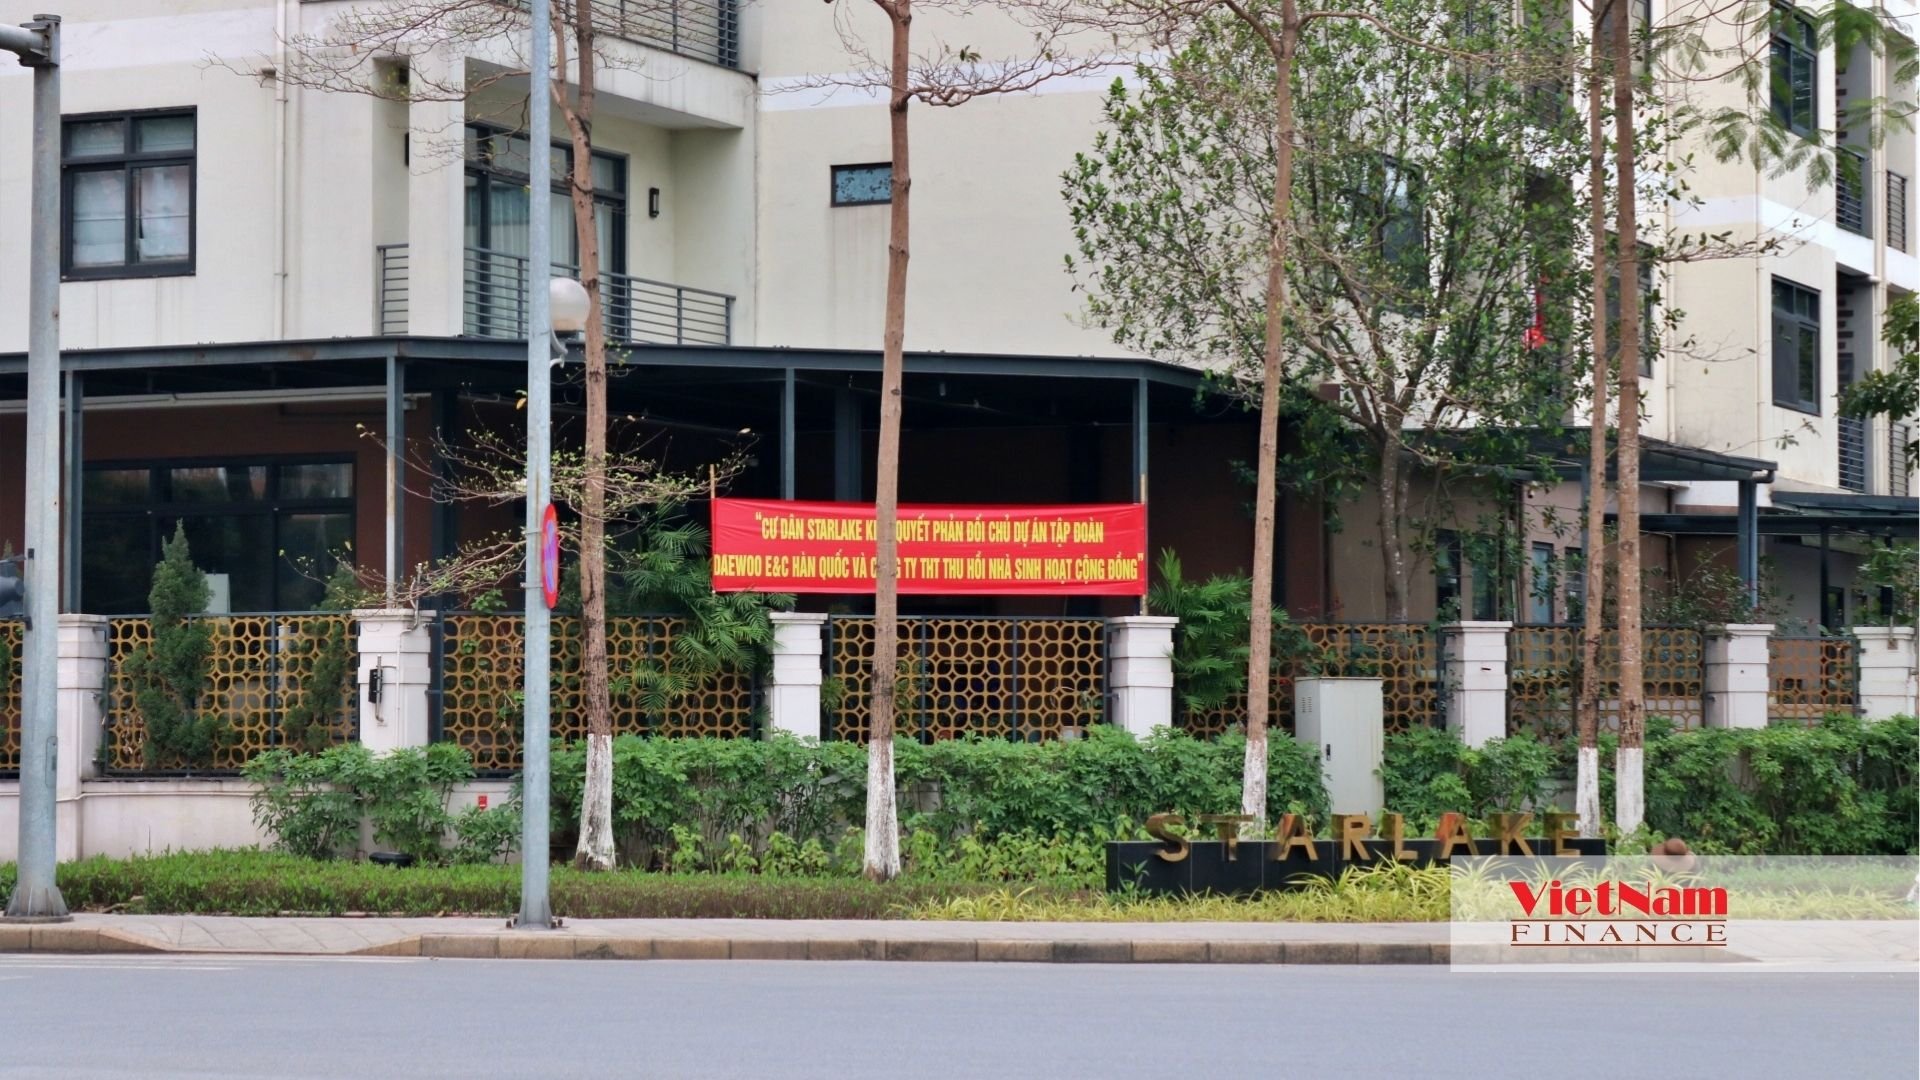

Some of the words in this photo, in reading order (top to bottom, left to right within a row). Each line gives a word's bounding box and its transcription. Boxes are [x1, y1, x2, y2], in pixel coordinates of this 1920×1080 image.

[781, 513, 804, 540] DÂN
[807, 518, 862, 541] STARLAKE
[896, 512, 929, 544] QUYẾT
[932, 513, 964, 542] PHẢN
[966, 513, 986, 543] ĐỐI
[988, 513, 1011, 543] CHỦ
[1013, 518, 1031, 548] DỰ
[1031, 516, 1048, 543] ÁN
[1049, 516, 1071, 548] TẬP
[1073, 516, 1104, 543] ĐOÀN
[713, 554, 762, 577] DAEWOO
[765, 555, 789, 577] E&C
[792, 551, 816, 578] HÀN
[819, 548, 850, 580] QUỐC
[852, 551, 868, 579] VÀ
[870, 556, 902, 579] CG
[903, 557, 917, 579] TY
[919, 557, 940, 579] THT
[942, 557, 964, 579] THU
[966, 550, 986, 580] HỒI
[988, 553, 1012, 580] NHÀ
[1014, 557, 1042, 580] SINH
[1044, 558, 1073, 585] HOẠT
[1075, 553, 1105, 585] CỘNG
[1146, 812, 1583, 863] STARLAKE
